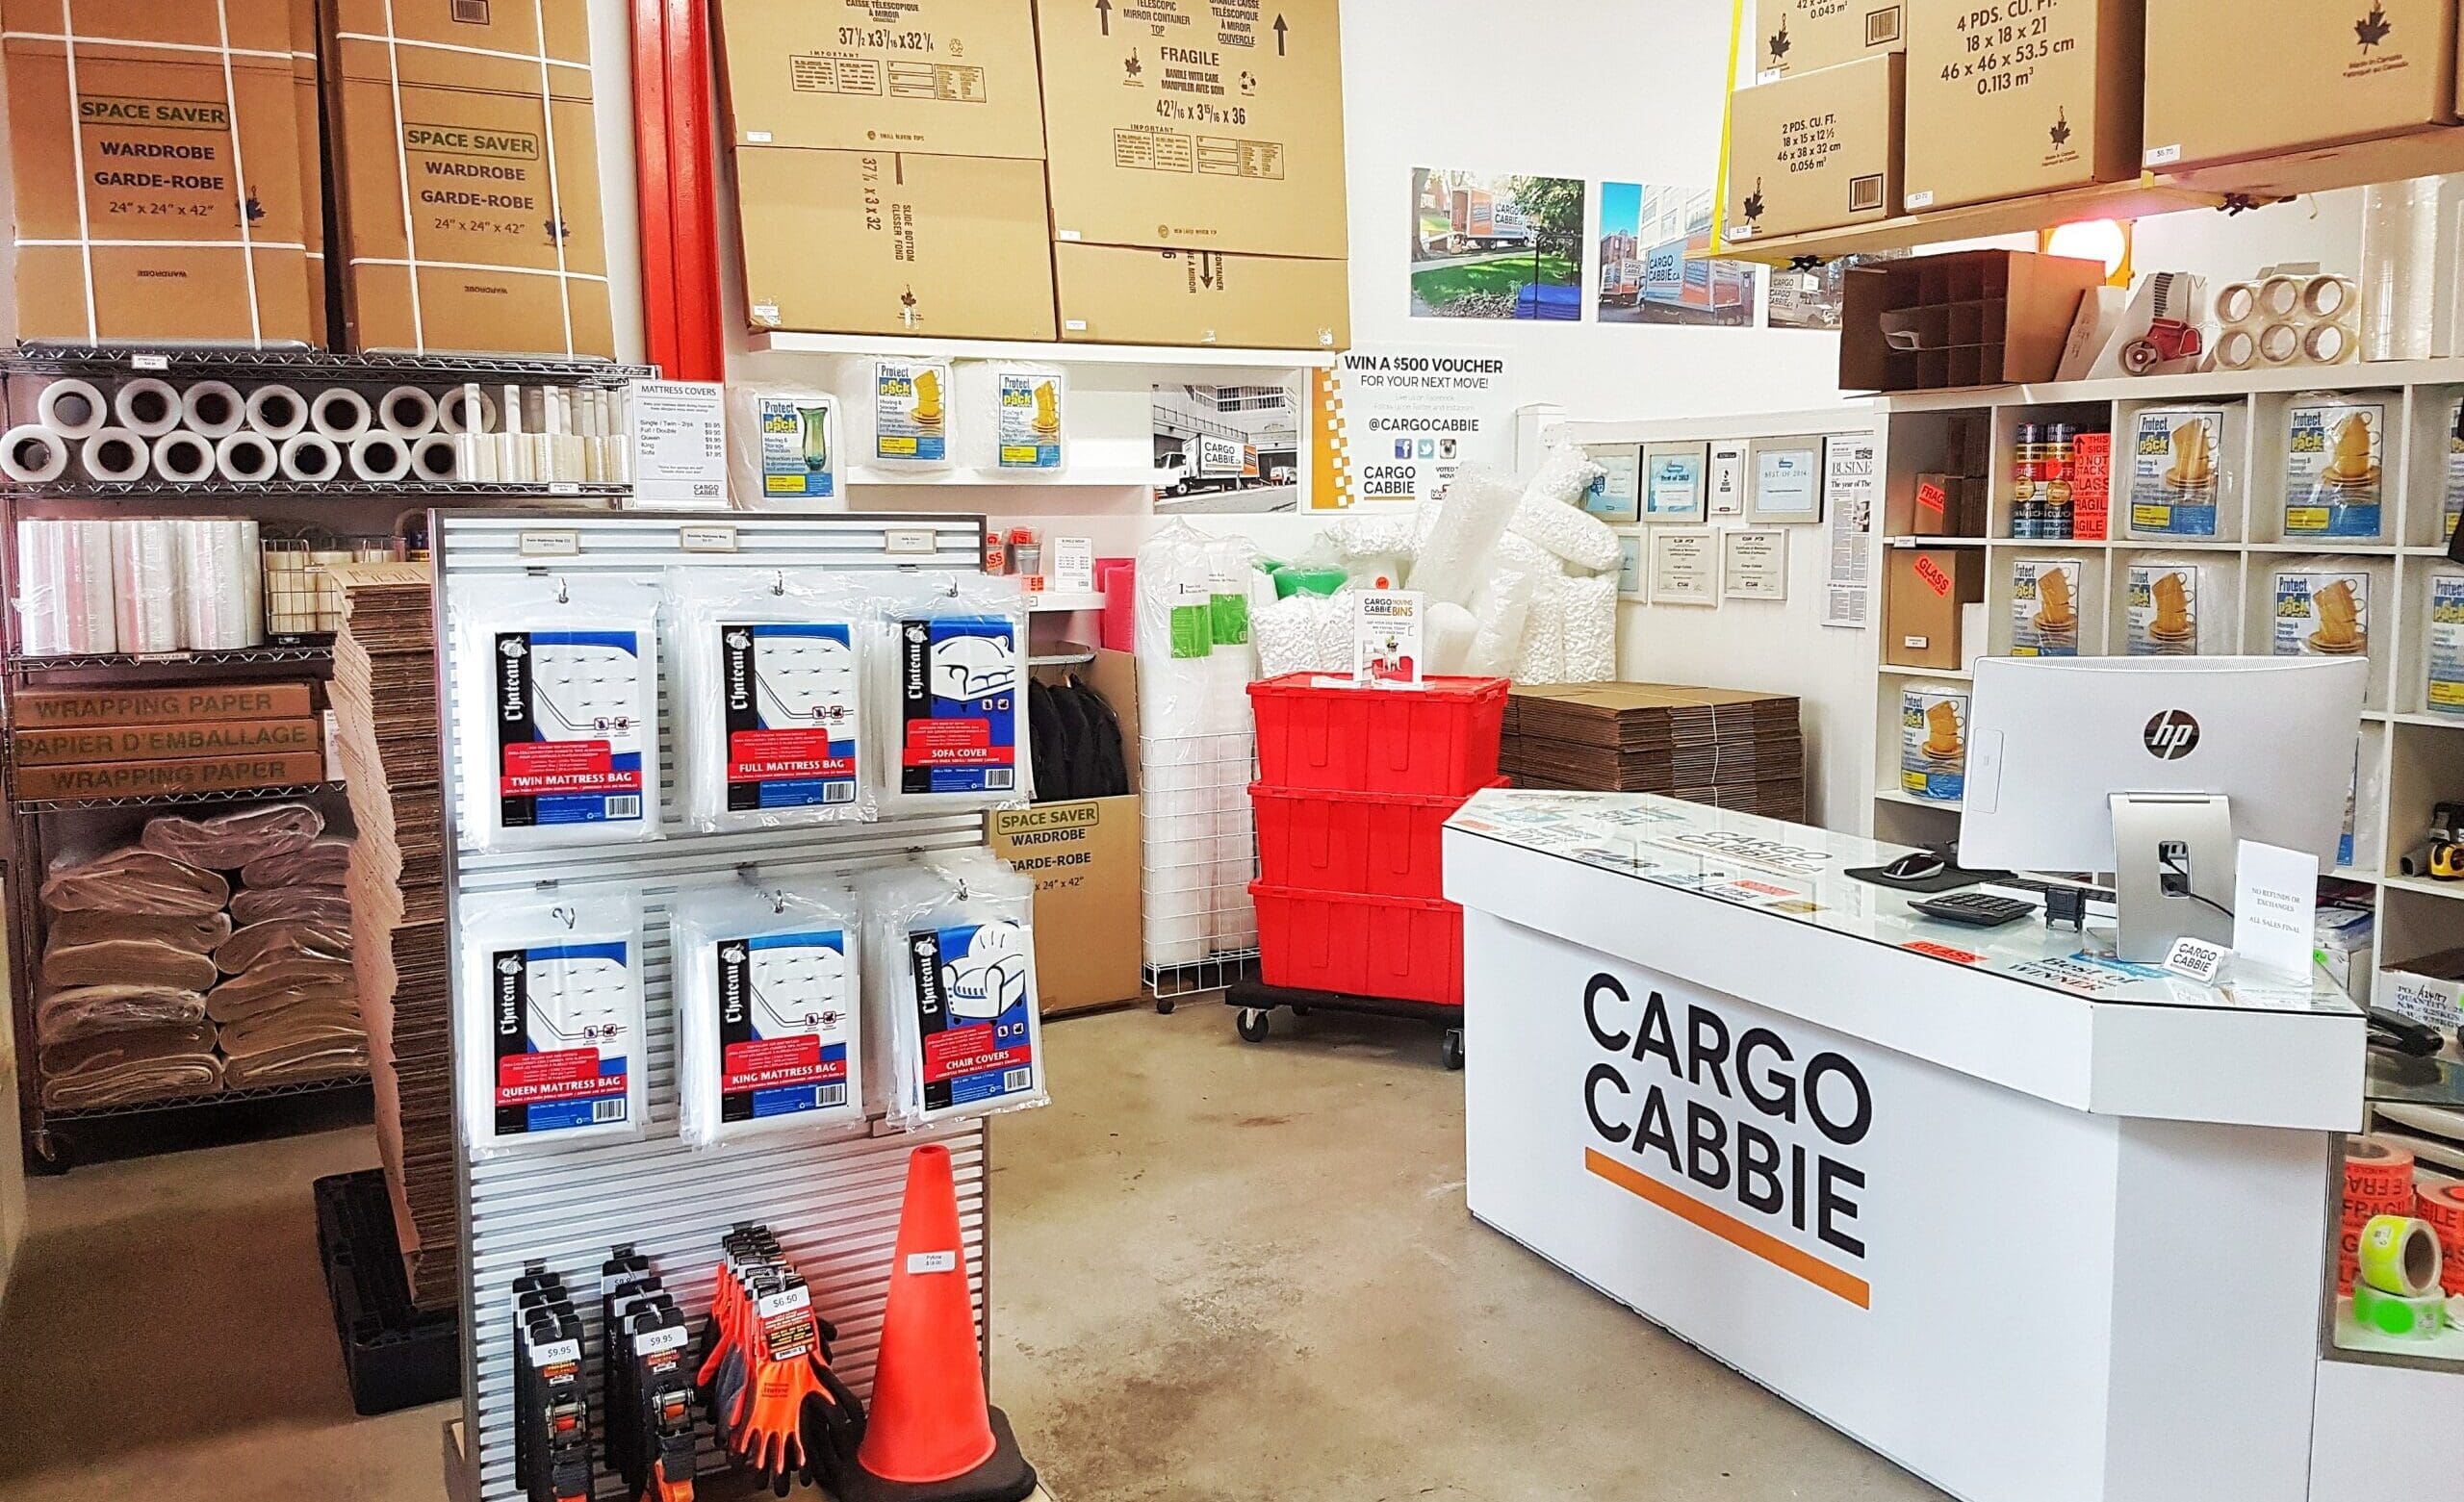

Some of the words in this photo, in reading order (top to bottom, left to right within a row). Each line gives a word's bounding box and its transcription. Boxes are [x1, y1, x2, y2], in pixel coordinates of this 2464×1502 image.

[1123, 9, 1151, 21] MIRROR
[1153, 12, 1191, 25] CONTAINER
[1810, 4, 1835, 19] 0.043
[1957, 15, 1965, 32] 4
[1971, 7, 2002, 29] PDS.
[2008, 0, 2033, 17] CU.
[1151, 24, 1165, 34] TOP
[1227, 21, 1251, 33] MIROIR
[1966, 35, 1980, 52] 18
[1985, 36, 1993, 48] x
[1998, 26, 2012, 43] 18
[2031, 16, 2046, 37] 21
[1218, 33, 1255, 45] COUVERCLE
[1161, 47, 1219, 66] FRAGILE
[1940, 64, 1960, 81] 46
[1978, 54, 1996, 71] 46
[2015, 39, 2048, 64] 53.5
[2053, 38, 2074, 53] cm
[1204, 72, 1219, 83] CARE
[1977, 72, 2011, 95] 0.113
[81, 102, 150, 119] SPACE
[156, 107, 226, 124] SAVER
[1232, 107, 1245, 125] 36
[1783, 124, 1788, 134] 2
[1790, 118, 1808, 132] PDS.
[1810, 115, 1822, 128] CU.
[1825, 114, 1835, 124] FT.
[407, 130, 469, 148] SPACE
[474, 136, 534, 154] SAVER
[1784, 137, 1791, 147] 18
[1800, 134, 1808, 143] 15
[99, 141, 215, 161] WARDROBE
[1778, 152, 1788, 162] 46
[1797, 148, 1808, 158] 38
[1816, 144, 1827, 154] 32
[1830, 142, 1841, 151] cm
[425, 161, 526, 181] WARDROBE
[1790, 159, 1814, 172] 0.056
[94, 172, 223, 190] GARDE-ROBE
[421, 190, 534, 210] GARDE-ROBE
[866, 216, 882, 231] 32
[903, 204, 913, 226] SLIDE
[905, 230, 915, 262] BOTTOM
[1650, 255, 1673, 269] CARGO
[1649, 267, 1672, 282] CABBIE
[881, 366, 909, 377] Protect
[1345, 356, 1376, 369] WIN
[1379, 357, 1391, 370] A
[1394, 357, 1428, 370] $500
[1432, 359, 1503, 373] VOUCHER
[641, 386, 683, 395] MATTRESS
[1005, 377, 1030, 390] Protect
[1361, 375, 1384, 386] FOR
[1387, 376, 1419, 387] YOUR
[1422, 377, 1451, 388] NEXT
[1453, 378, 1488, 389] MOVE!
[765, 401, 794, 413] Protect
[1369, 419, 1478, 432] @CARGOCABBIE
[2142, 417, 2168, 430] Protect
[2294, 412, 2322, 426] Protect
[1204, 442, 1235, 454] CARGO
[1204, 452, 1235, 464] CABBIE
[2087, 455, 2110, 465] NOT
[1364, 466, 1416, 479] CARGO
[1833, 462, 1872, 473] BUSINE
[1363, 481, 1415, 494] CABBIE
[1921, 485, 1944, 505] FRAG
[1919, 558, 1949, 590] GLASS
[2279, 576, 2307, 592] Protect
[1392, 606, 1413, 616] BINS
[731, 650, 749, 710] Chateau
[908, 645, 925, 700] Chateau
[504, 658, 526, 722] Chateau
[36, 697, 180, 719] WRAPPING
[190, 694, 271, 712] PAPER
[16, 733, 114, 757] PAPIER
[123, 726, 308, 752] D'EMBALLAGE
[932, 749, 955, 757] SOFA
[53, 767, 193, 789] WRAPPING
[202, 761, 285, 780] PAPER
[739, 763, 762, 773] FULL
[766, 760, 819, 772] MATTRESS
[823, 759, 844, 769] BAG
[511, 776, 543, 786] TWIN
[546, 774, 605, 785] MATTRESS
[608, 773, 632, 781] BAG
[1002, 813, 1046, 828] SPACE
[1050, 808, 1095, 824] SAVER
[1012, 828, 1086, 846] WARDROBE
[1706, 831, 1833, 860] CARGO
[2263, 889, 2290, 901] REFUNDS
[2257, 899, 2295, 912] EXCHANGES
[2263, 919, 2280, 929] SALES
[2282, 923, 2299, 933] FINAL
[2179, 943, 2218, 961] CARGO
[2040, 957, 2101, 976] Best
[2173, 954, 2211, 973] CABBIE
[920, 957, 938, 1014] Chateau
[2009, 964, 2105, 991] WINNER
[725, 965, 744, 1024] Chateau
[500, 976, 520, 1035] Chateau
[946, 1059, 973, 1070] CHAIR
[976, 1051, 1010, 1063] COVERS
[1583, 972, 1872, 1145] CARGO
[732, 1074, 757, 1084] KING
[761, 1067, 813, 1081] MATTRESS
[815, 1062, 836, 1072] BAG
[502, 1086, 537, 1097] QUEEN
[540, 1081, 595, 1093] MATTRESS
[599, 1077, 621, 1086] BAG
[1584, 1062, 1865, 1260] CABBIE
[773, 1294, 798, 1309] $6.50
[651, 1335, 673, 1347] $9.95
[548, 1346, 572, 1358] $9.95
